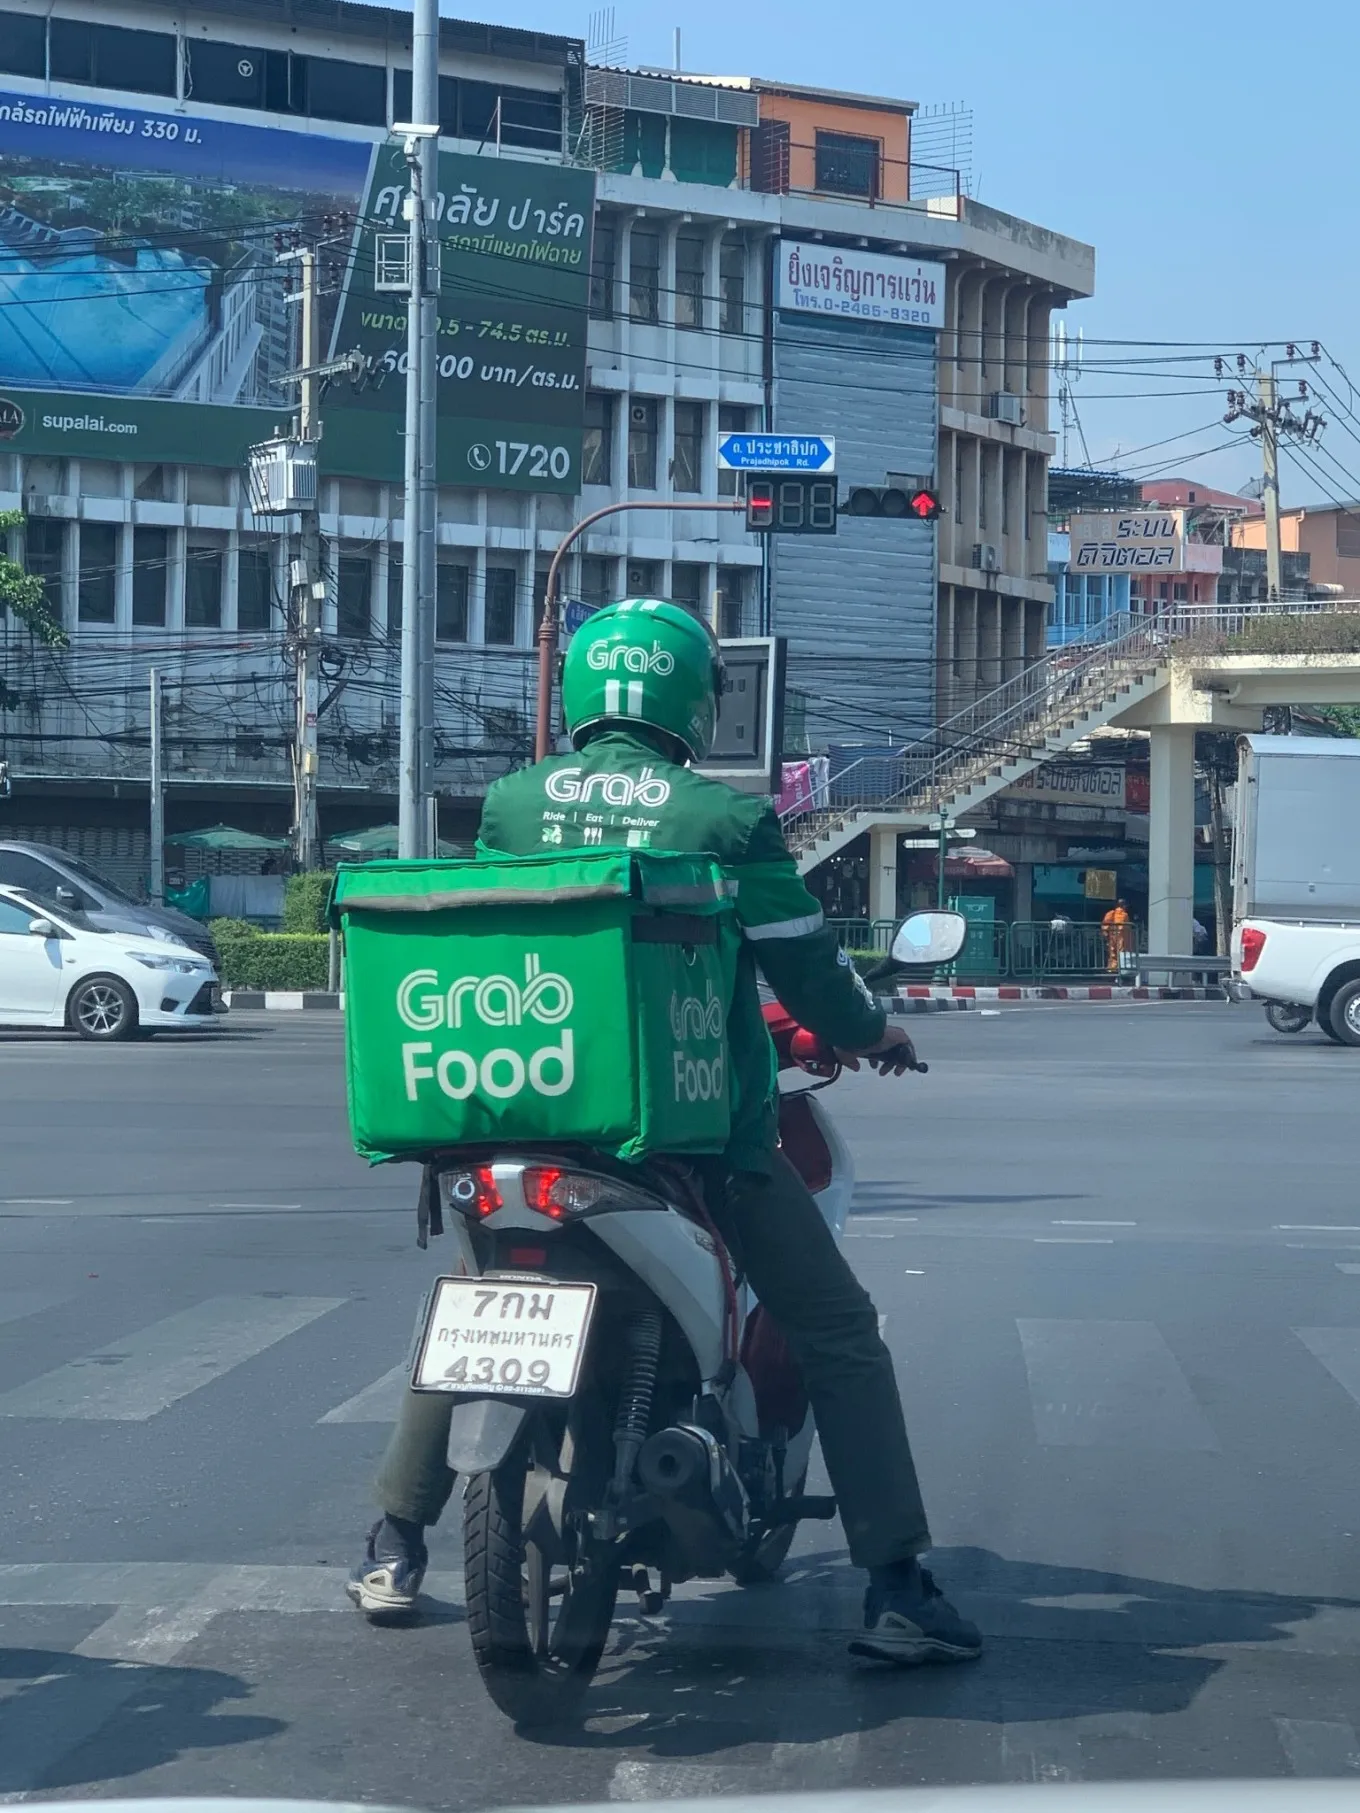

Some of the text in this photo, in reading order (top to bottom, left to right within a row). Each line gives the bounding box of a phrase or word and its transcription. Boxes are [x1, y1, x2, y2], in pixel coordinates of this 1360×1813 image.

[141, 119, 178, 140] 330
[184, 128, 202, 144] ม.
[374, 183, 585, 238] ศุาลัย ปาร์ค
[788, 246, 936, 306] ยิ่งเจริญการแว่น
[478, 320, 522, 342] 74.5
[481, 365, 580, 390] บาท/ตร.ม.
[43, 415, 138, 434] supalai.com
[495, 440, 570, 479] 1720
[741, 457, 789, 467] Prajadhipok
[747, 440, 818, 456] ประชาธิปก
[1117, 519, 1178, 538] ระบบ
[1077, 543, 1174, 566] ดิจิตอล
[587, 639, 675, 676] Grab
[545, 766, 670, 808] Grab
[543, 811, 660, 827] Ride Eat Deliver
[397, 953, 573, 1031] Grab
[670, 978, 723, 1041] Grab
[402, 1029, 574, 1101] Food
[674, 1043, 724, 1102] Food
[473, 1290, 555, 1321] 7กม
[438, 1327, 574, 1348] กรุงเทพมหานคร
[444, 1356, 550, 1386] 4309
